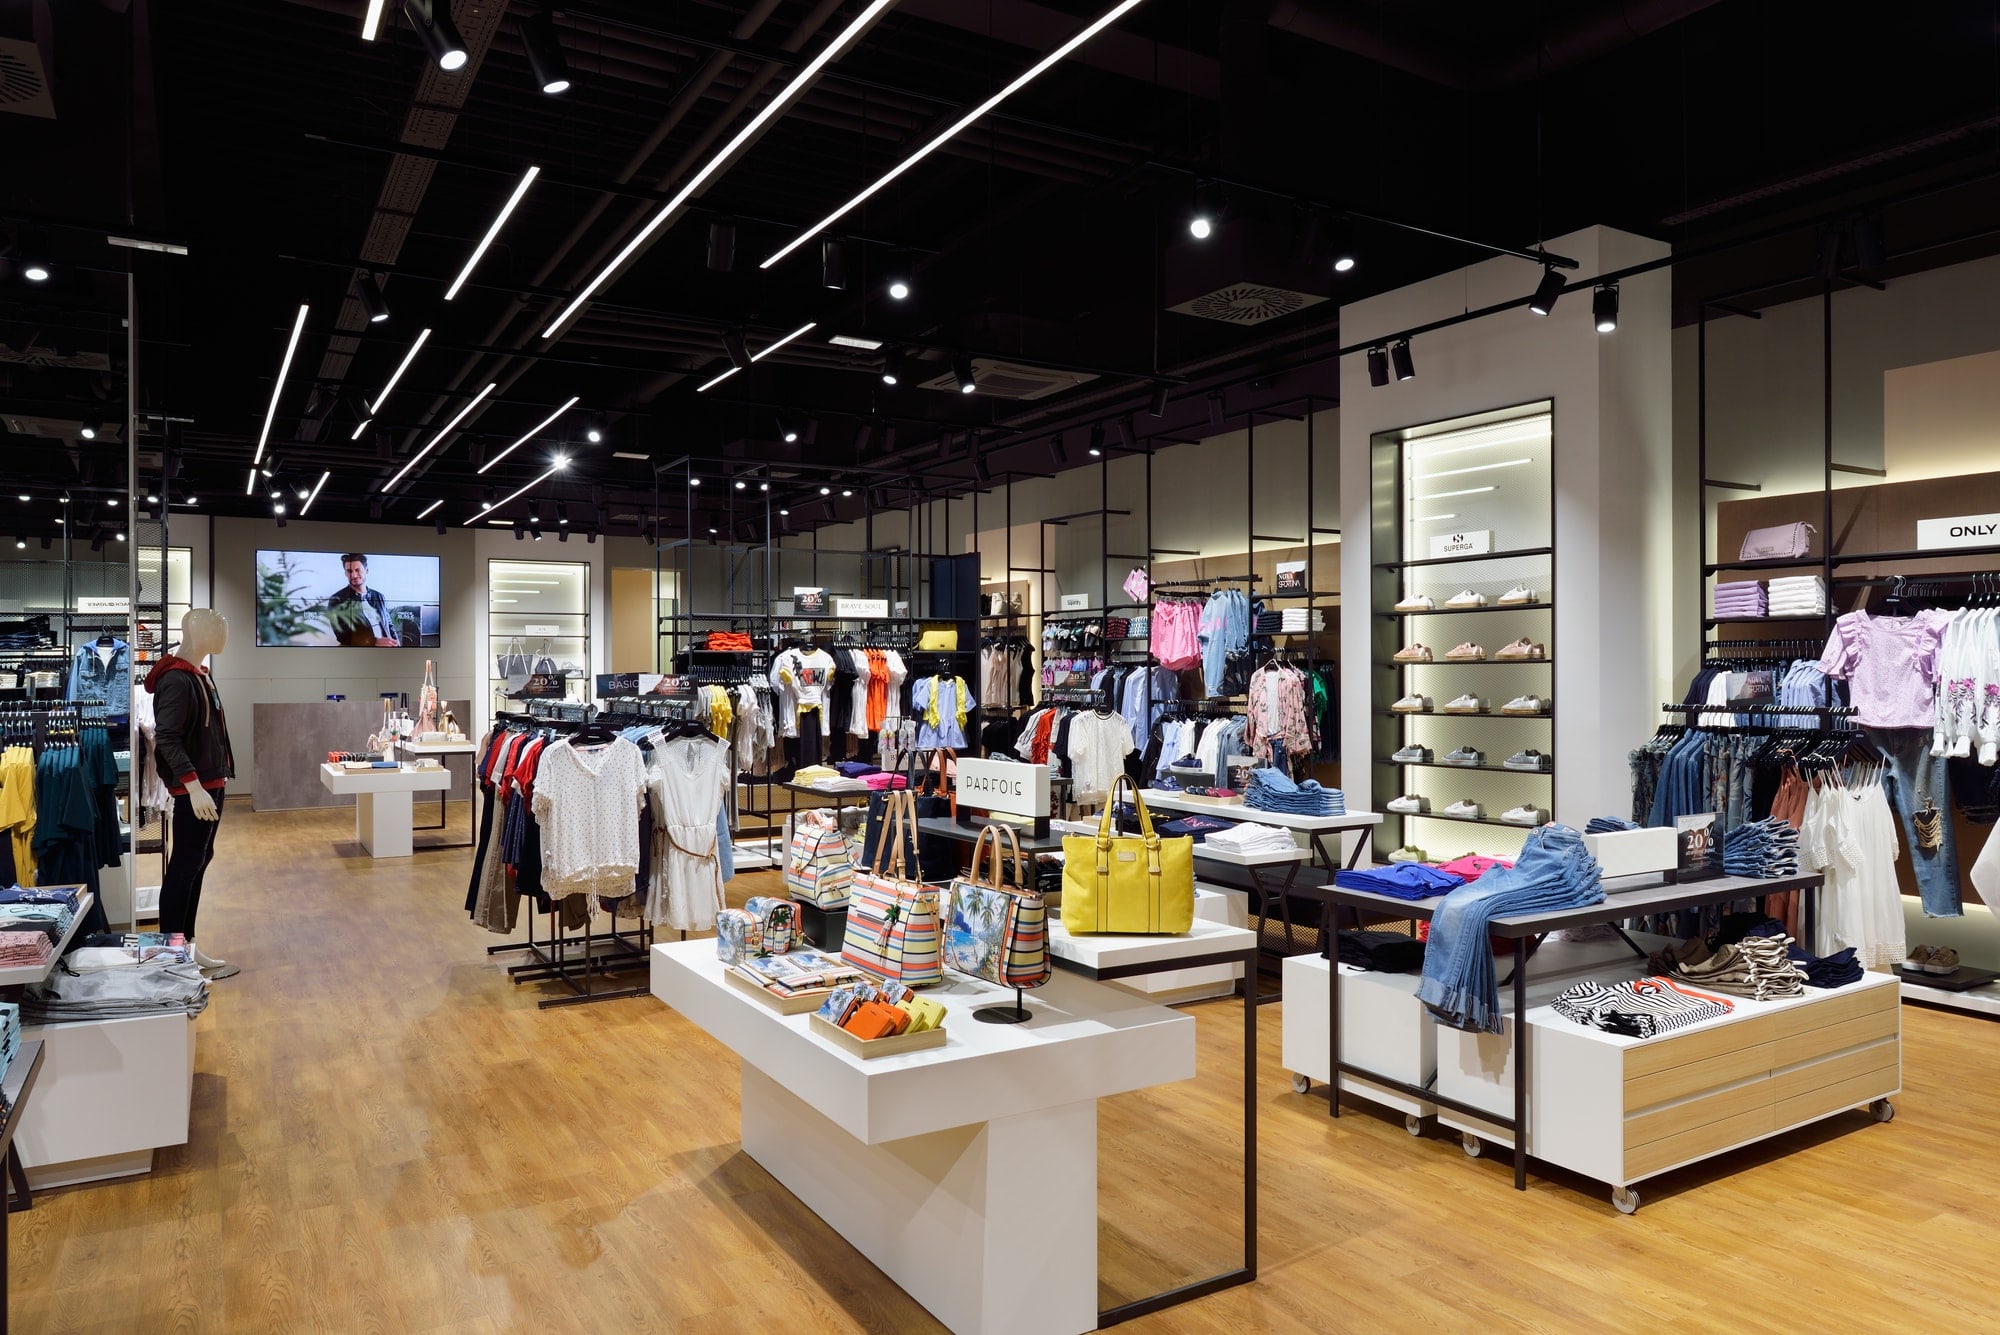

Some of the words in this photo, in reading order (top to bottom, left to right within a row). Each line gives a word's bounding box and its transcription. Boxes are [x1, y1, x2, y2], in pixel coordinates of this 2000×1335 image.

[1949, 524, 1998, 538] ONLY
[1443, 543, 1473, 552] SUPERGA
[802, 593, 822, 603] 20%
[532, 674, 558, 686] 20%
[664, 675, 690, 687] 20%
[1070, 671, 1086, 680] 20%
[966, 775, 1022, 796] PARFOIS
[1687, 826, 1714, 849] 20%
